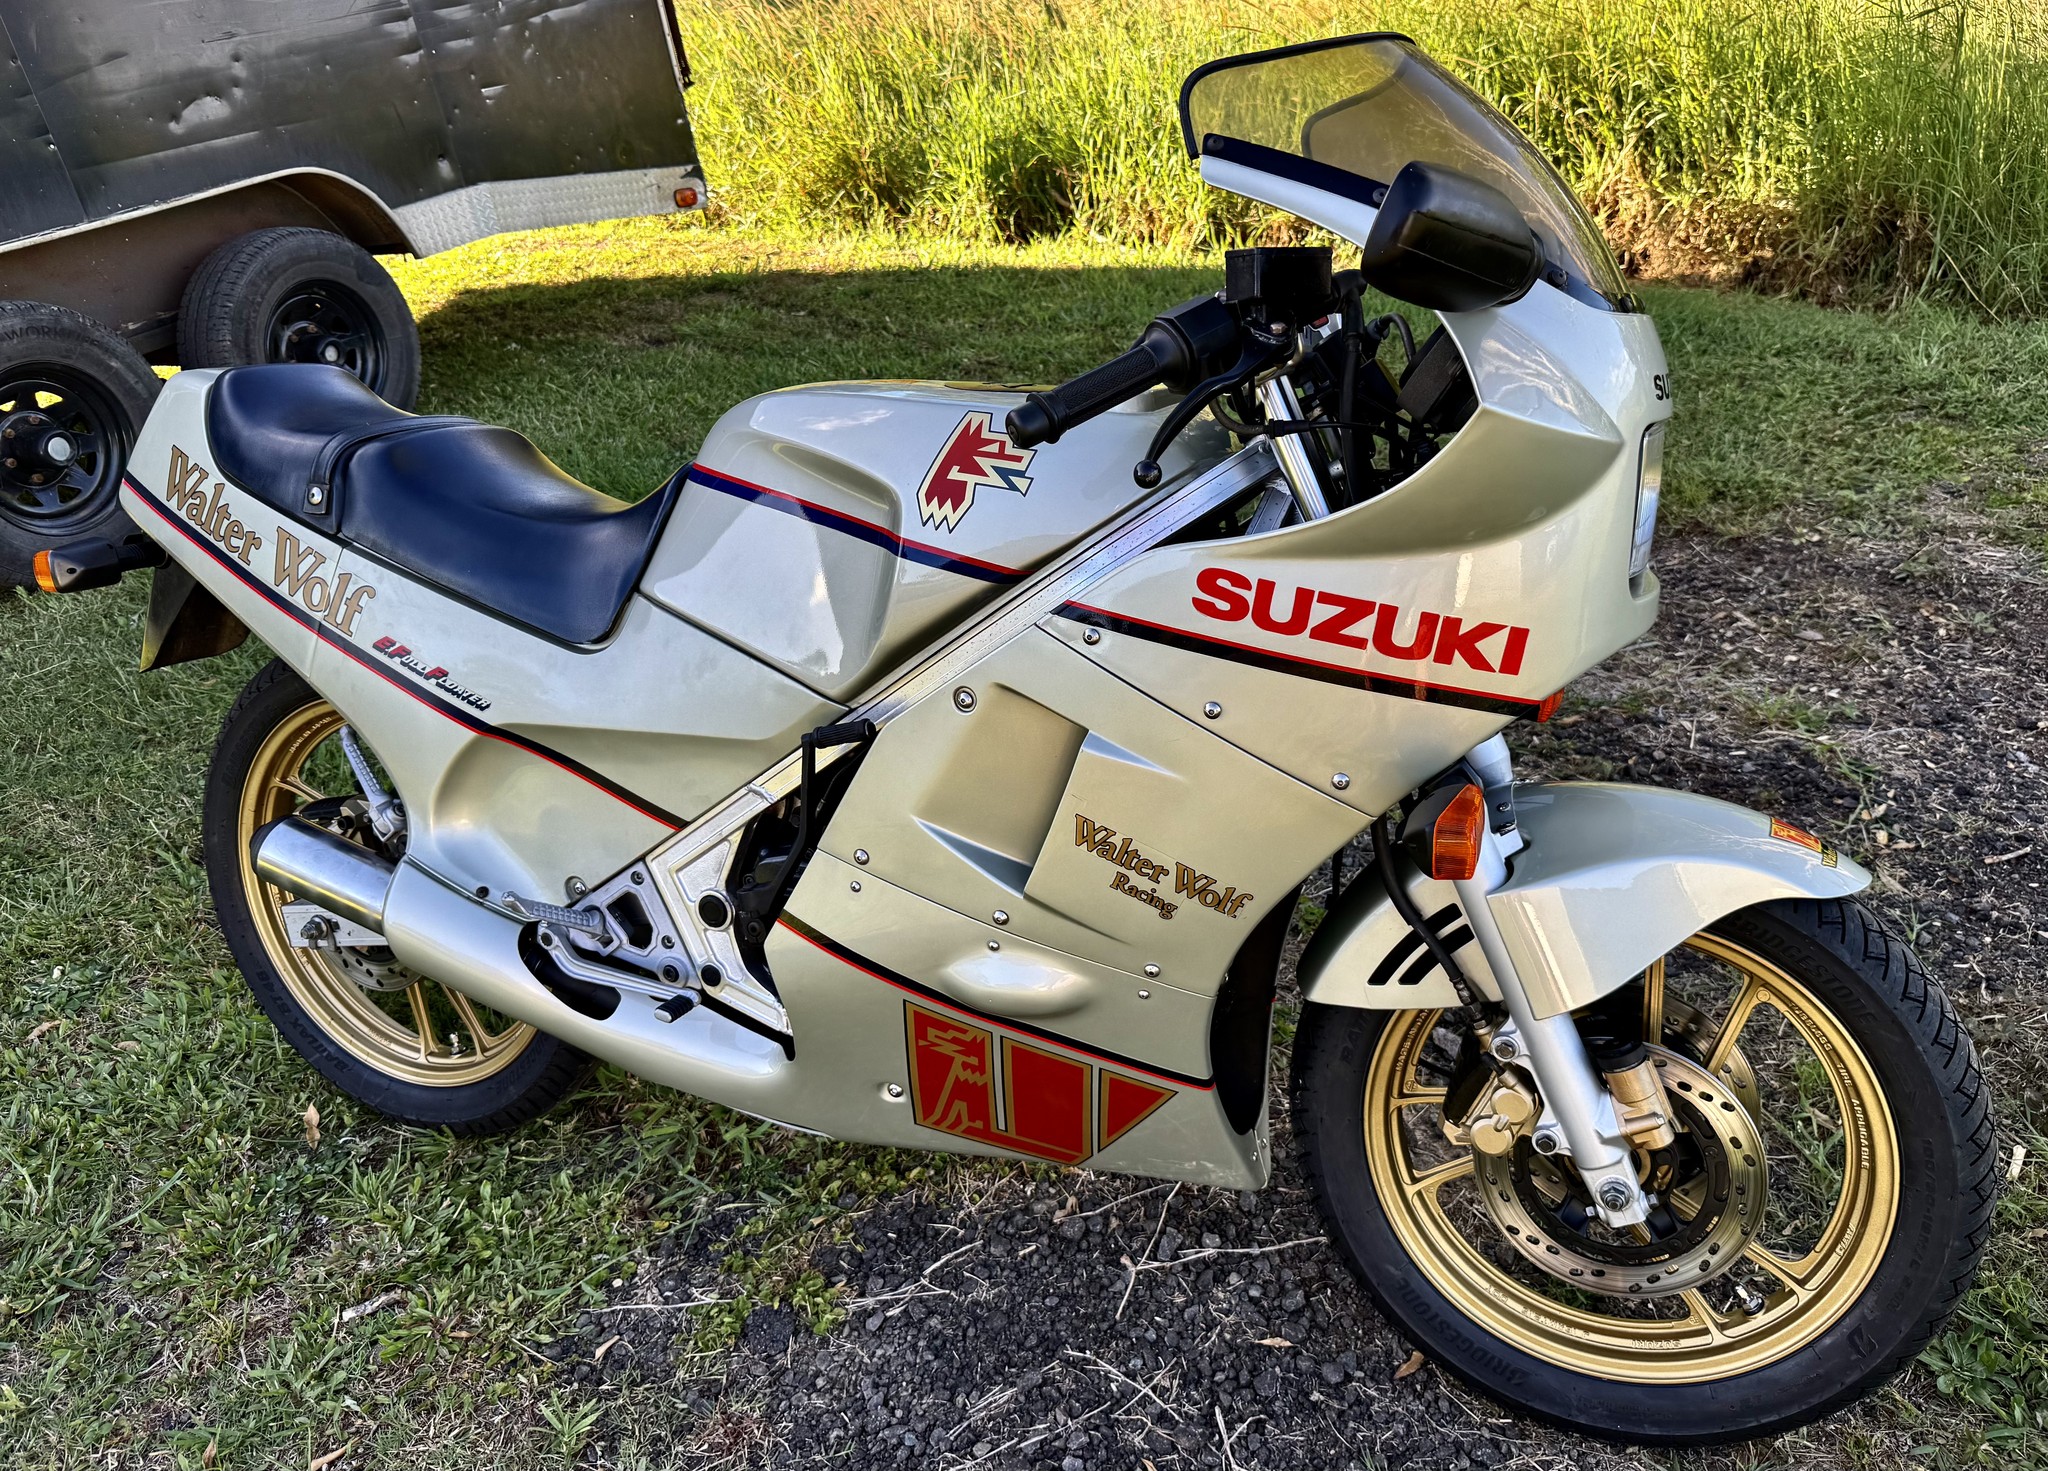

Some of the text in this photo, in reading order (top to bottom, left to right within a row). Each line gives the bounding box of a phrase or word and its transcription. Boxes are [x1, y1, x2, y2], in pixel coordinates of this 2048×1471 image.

[166, 444, 377, 638] Walter Wolf
[1191, 567, 1530, 676] SUZUKI
[1074, 813, 1254, 919] Walter Wolf
[1109, 871, 1179, 920] Racing
[1725, 913, 1880, 1027] BRIDGESTONE
[1789, 1002, 1870, 1171] TUBELESS TIRE APPLICABLE
[1395, 1275, 1527, 1387] BRIDGESTONE
[1631, 1339, 1682, 1349] SUZUKI
